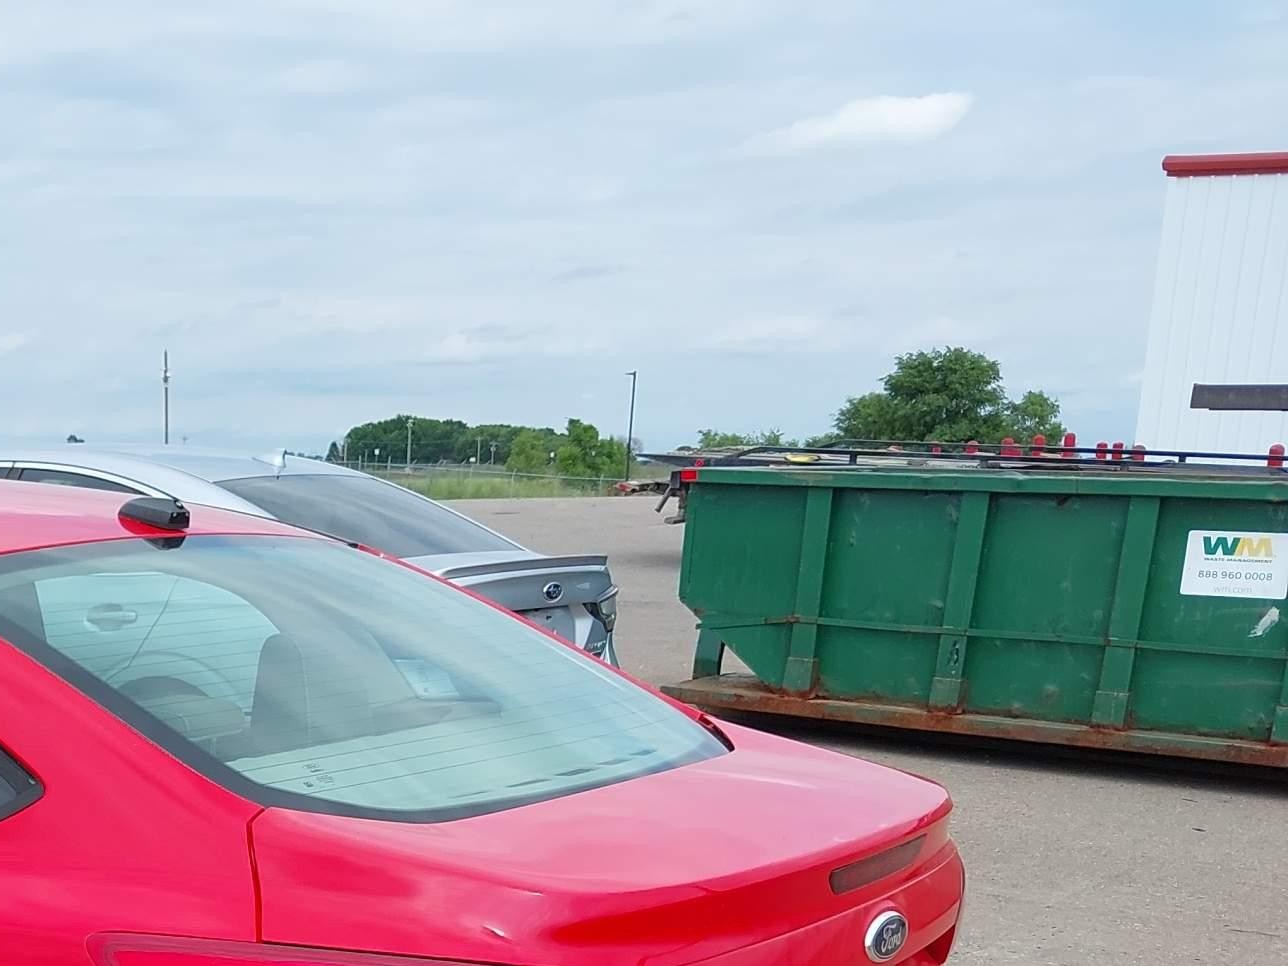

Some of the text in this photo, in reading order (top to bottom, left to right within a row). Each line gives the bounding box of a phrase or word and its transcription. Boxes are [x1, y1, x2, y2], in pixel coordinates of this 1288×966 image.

[1203, 535, 1273, 557] WM
[1221, 571, 1242, 580] 960
[1244, 572, 1273, 581] 0008
[880, 922, 903, 954] Ford
